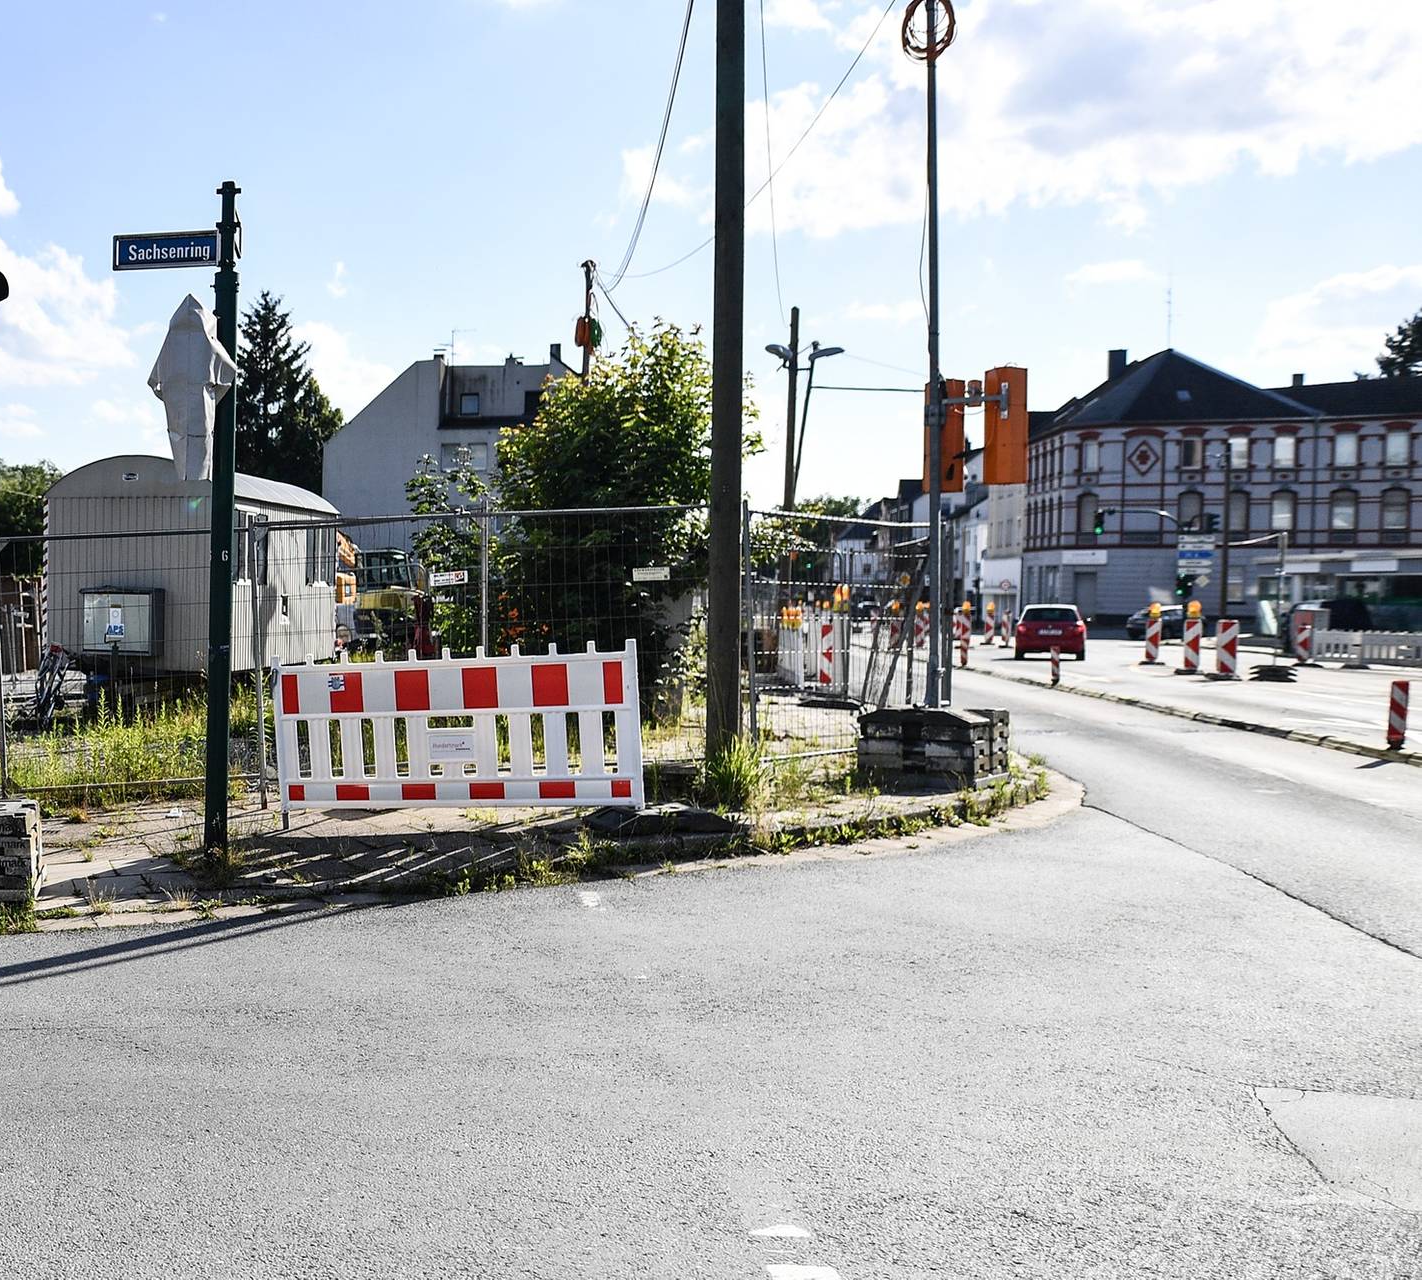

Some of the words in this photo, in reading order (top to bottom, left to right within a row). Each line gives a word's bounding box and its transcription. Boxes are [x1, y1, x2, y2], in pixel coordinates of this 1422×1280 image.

[128, 241, 210, 261] Sachsenring
[221, 550, 229, 561] 6
[107, 625, 124, 635] APS
